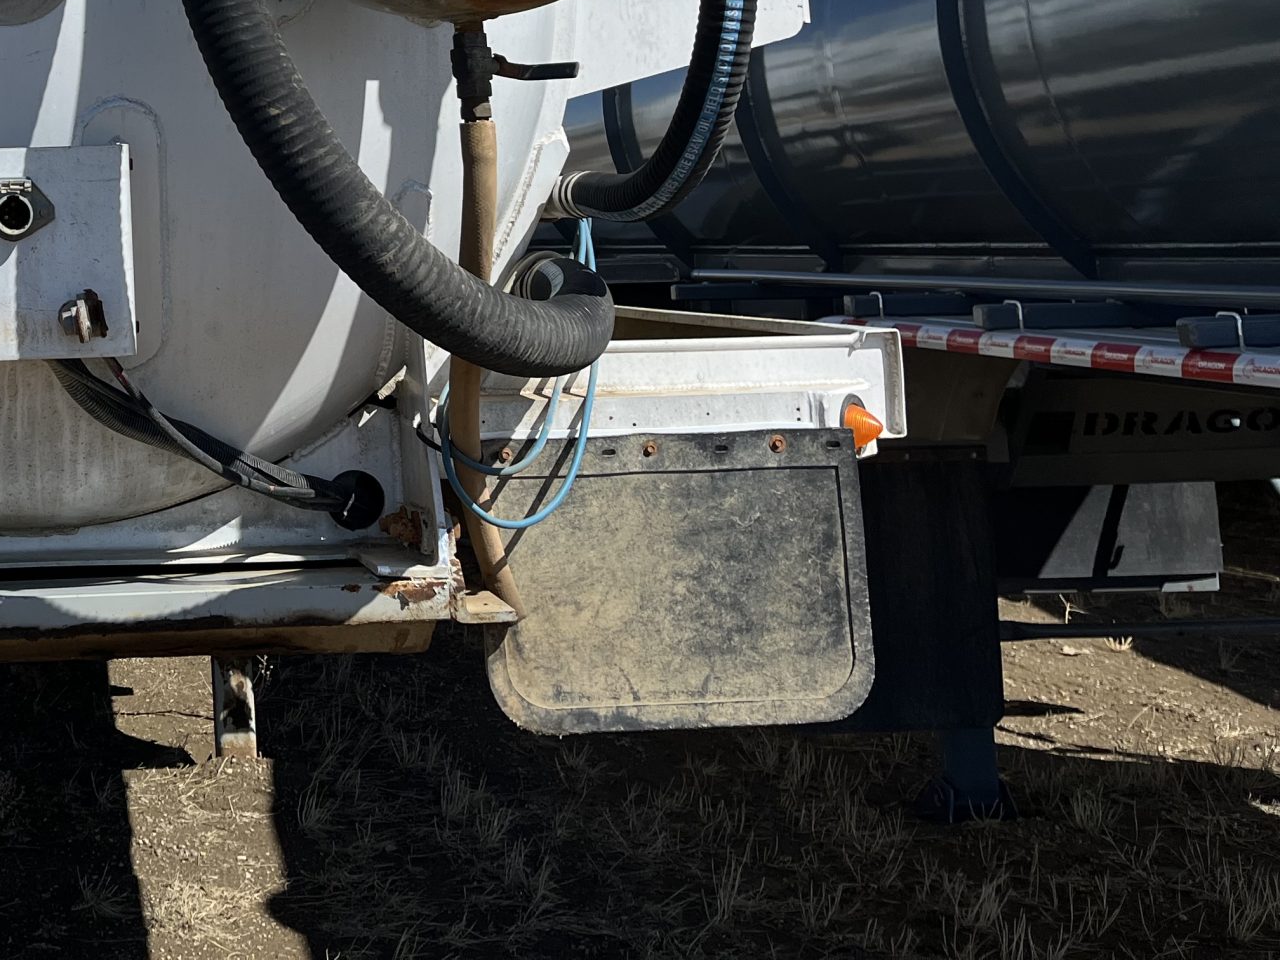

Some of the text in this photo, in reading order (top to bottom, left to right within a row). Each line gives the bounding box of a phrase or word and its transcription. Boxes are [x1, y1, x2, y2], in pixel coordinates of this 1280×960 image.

[704, 85, 724, 115] FIELD
[697, 117, 713, 133] OIL
[1197, 360, 1226, 370] DRAGON
[1082, 407, 1280, 437] DRAGO
